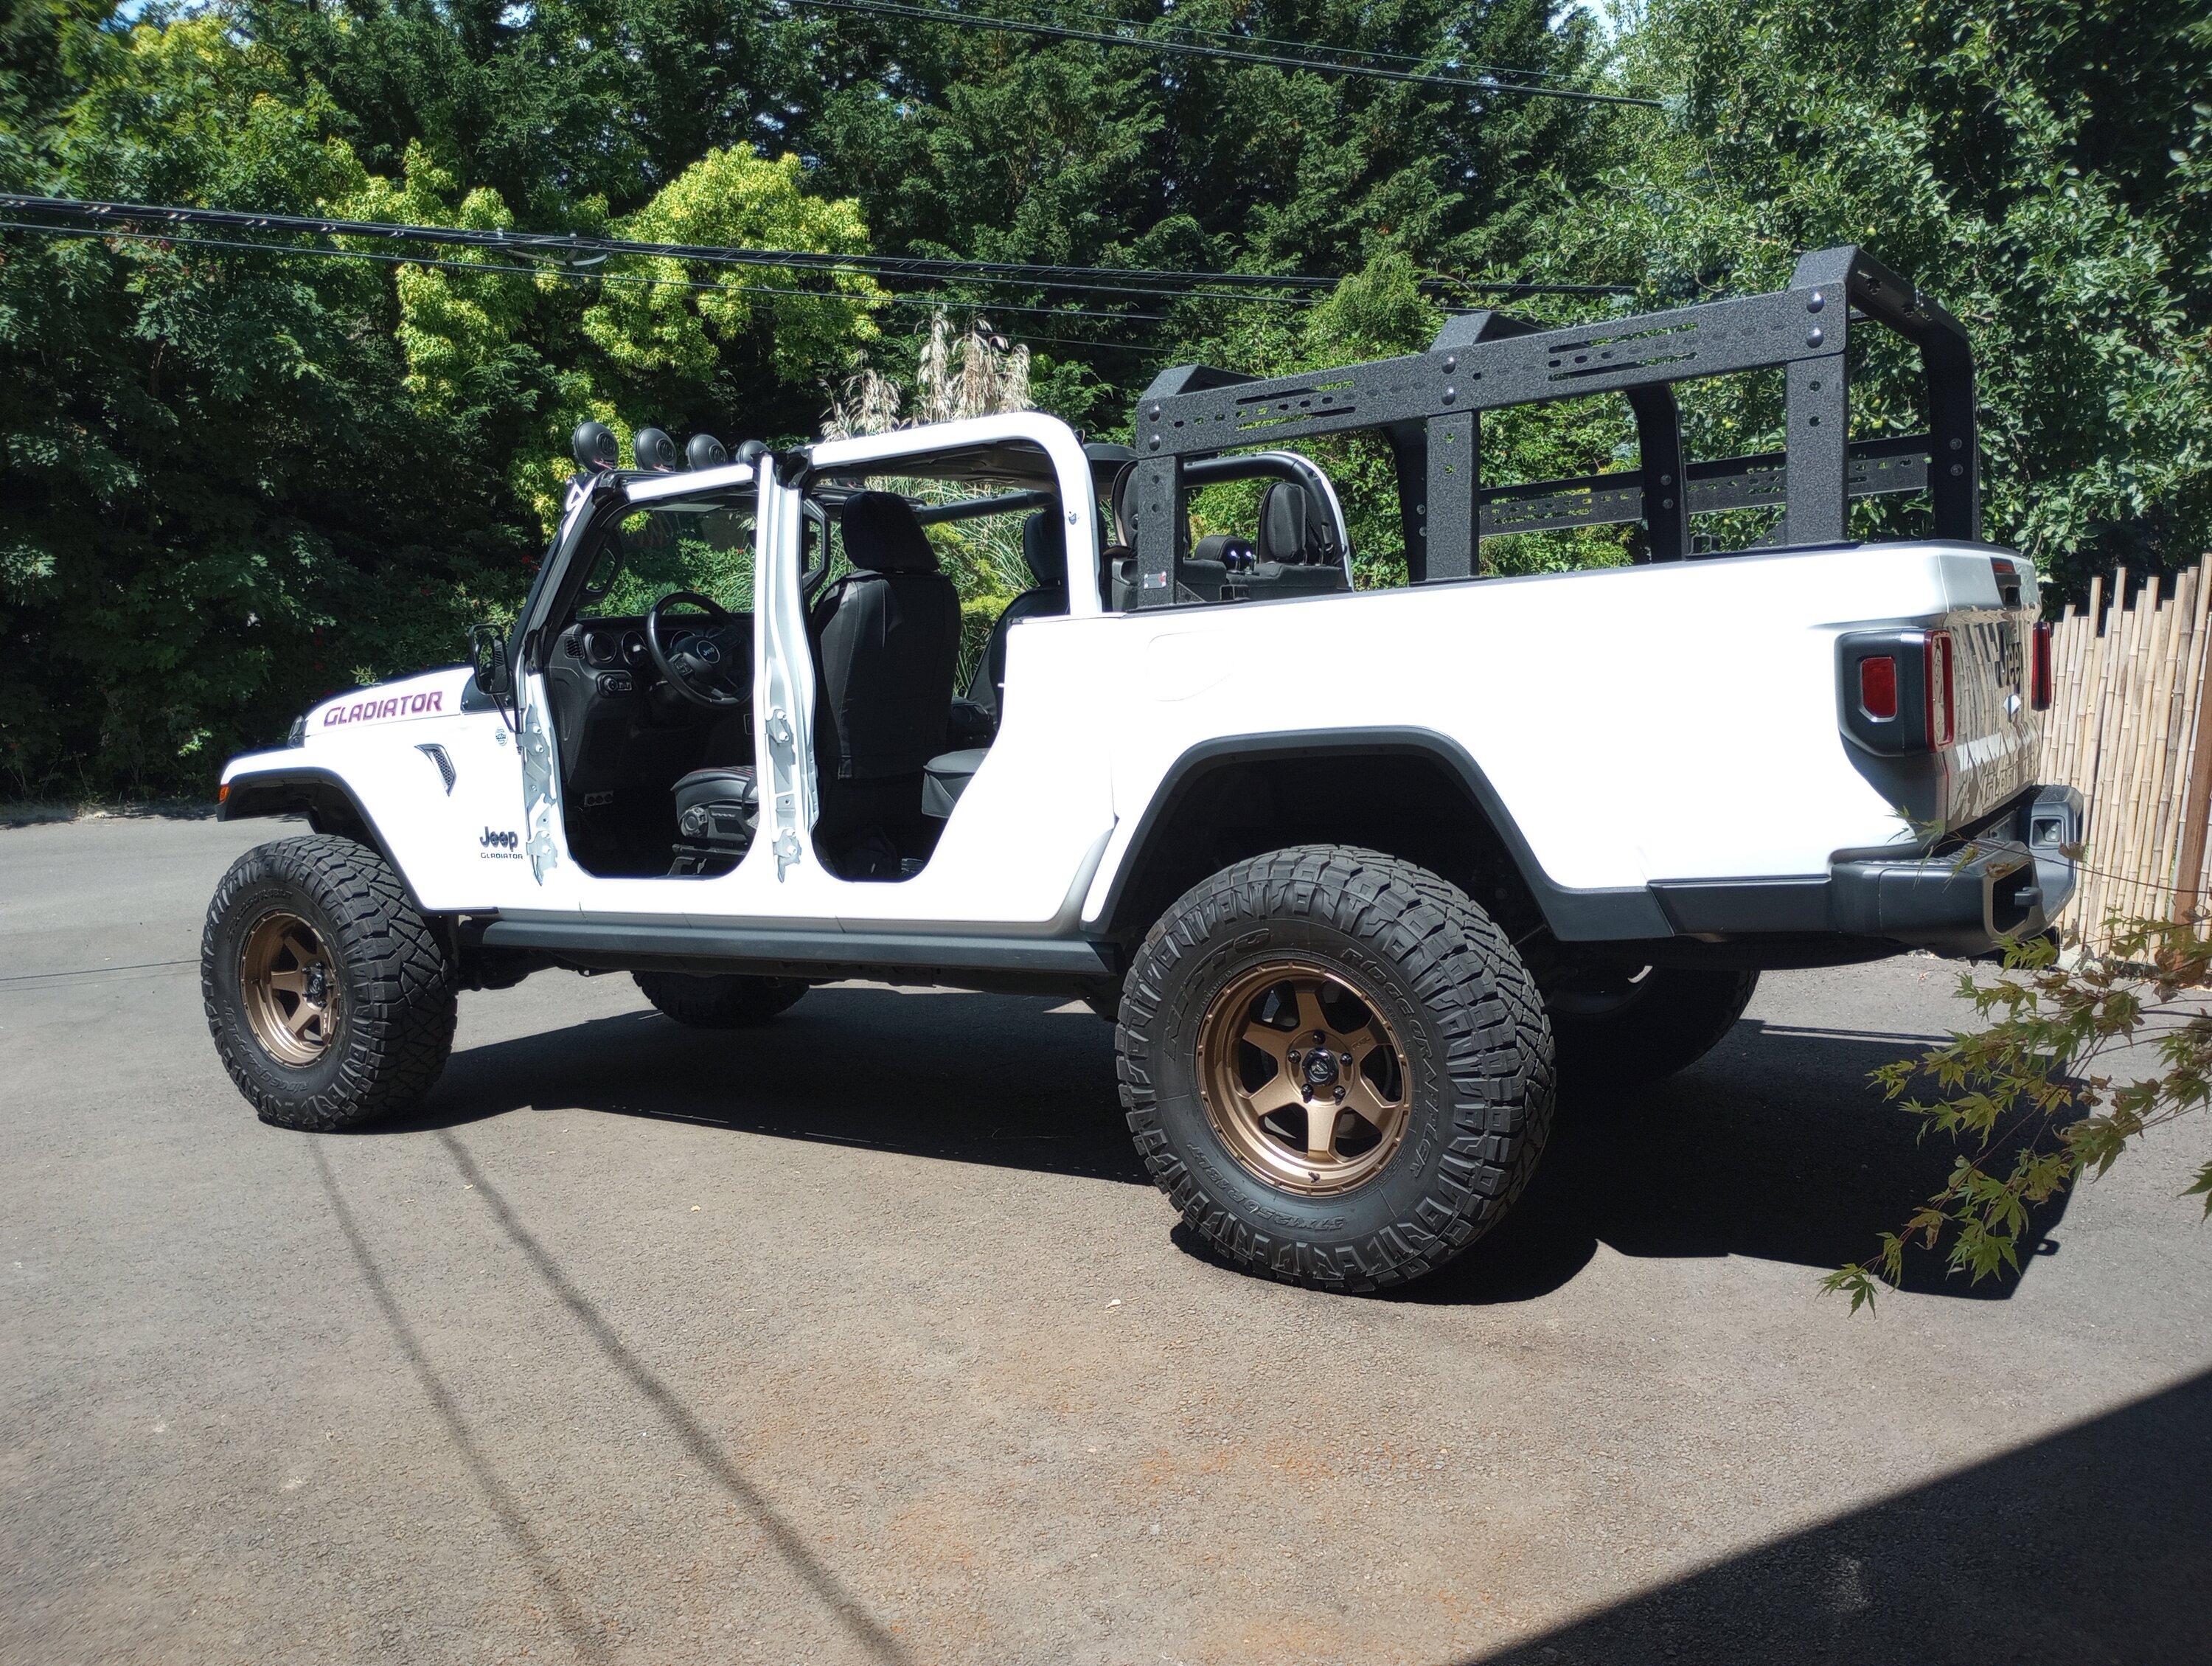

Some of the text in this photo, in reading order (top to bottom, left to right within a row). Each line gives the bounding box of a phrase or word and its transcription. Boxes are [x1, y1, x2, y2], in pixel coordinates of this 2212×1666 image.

[324, 691, 442, 726] GLADIATOR
[479, 826, 518, 852] Jeep
[1163, 927, 1271, 1061] NITTO
[1340, 947, 1415, 1016] RIDGE
[1408, 1018, 1439, 1179] GRAPPLER
